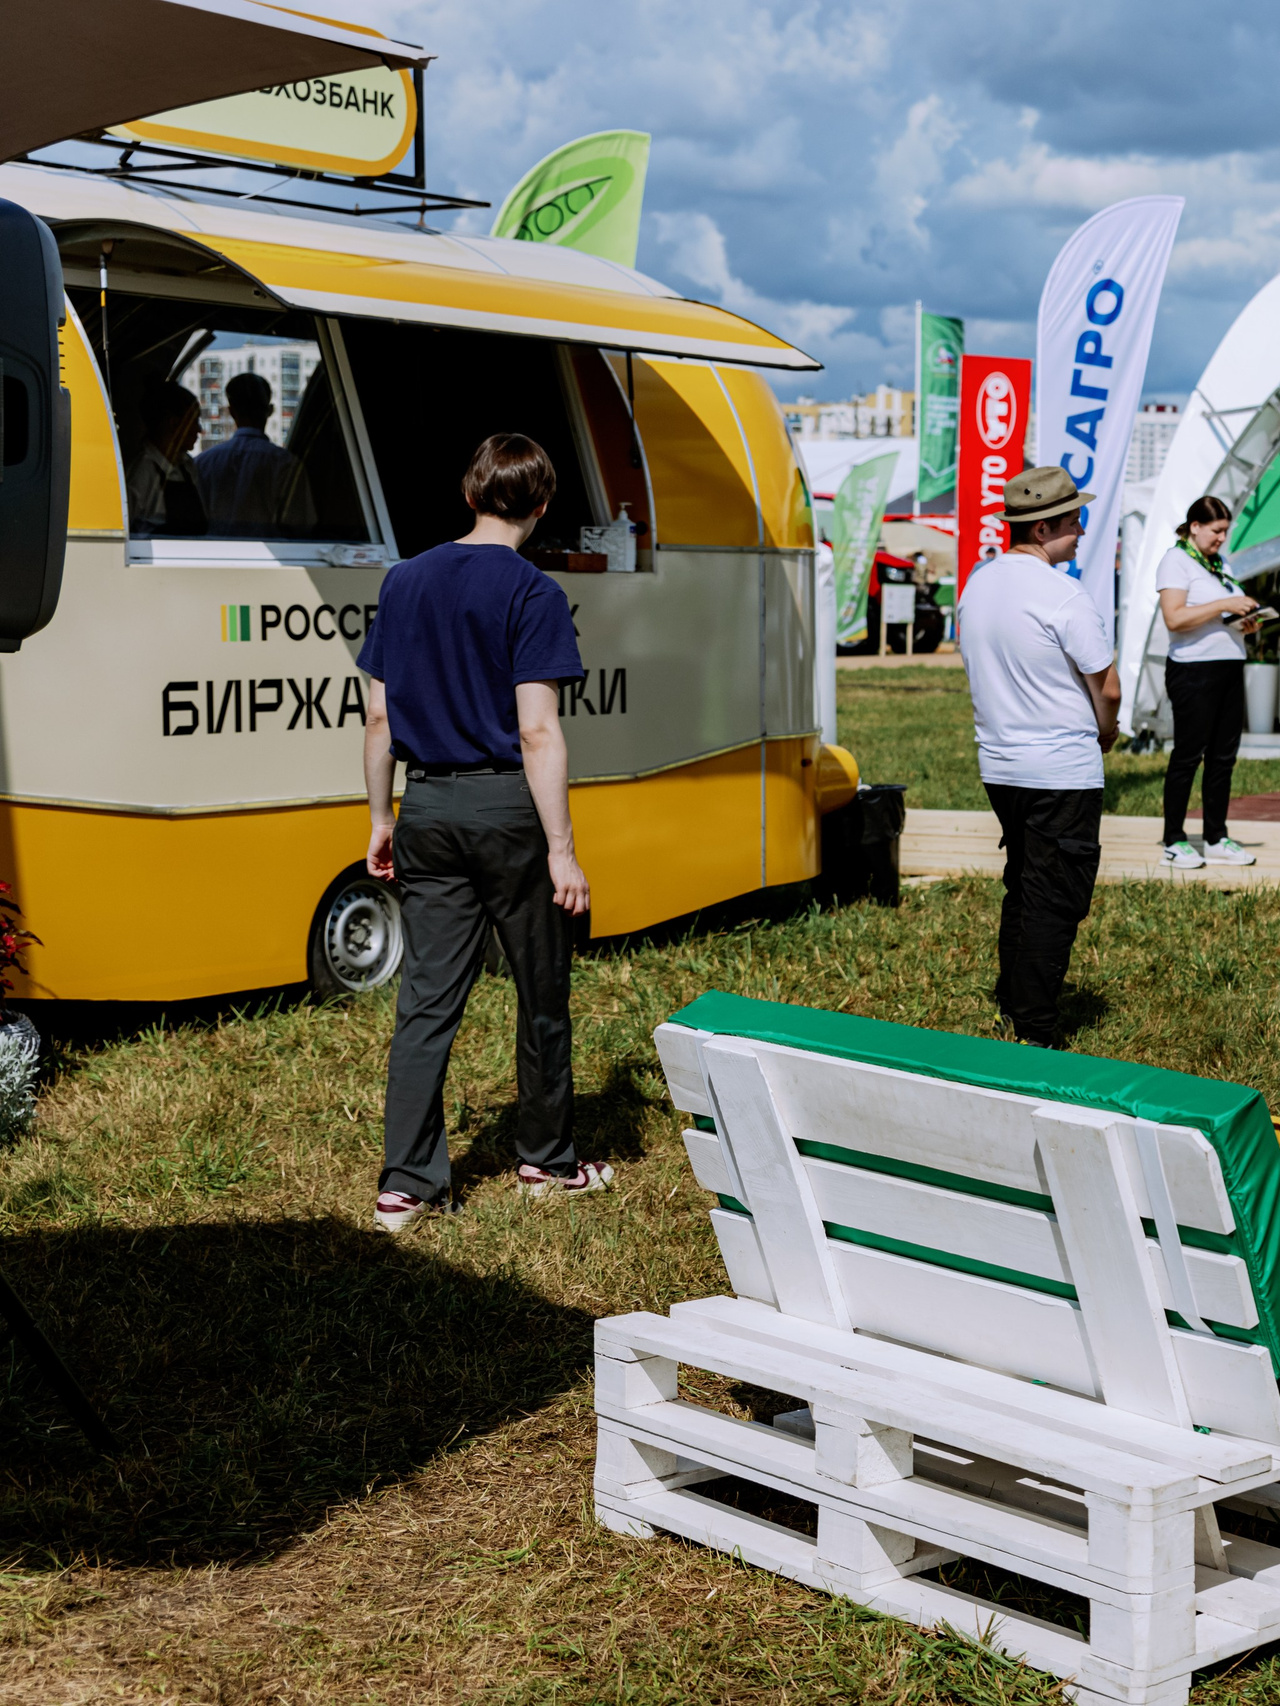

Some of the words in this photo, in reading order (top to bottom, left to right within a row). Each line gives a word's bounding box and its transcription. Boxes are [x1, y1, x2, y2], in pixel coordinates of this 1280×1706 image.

[250, 79, 396, 119] ХОЗБАНК
[1052, 278, 1125, 581] САГРО
[162, 676, 366, 737] БИРЖА
